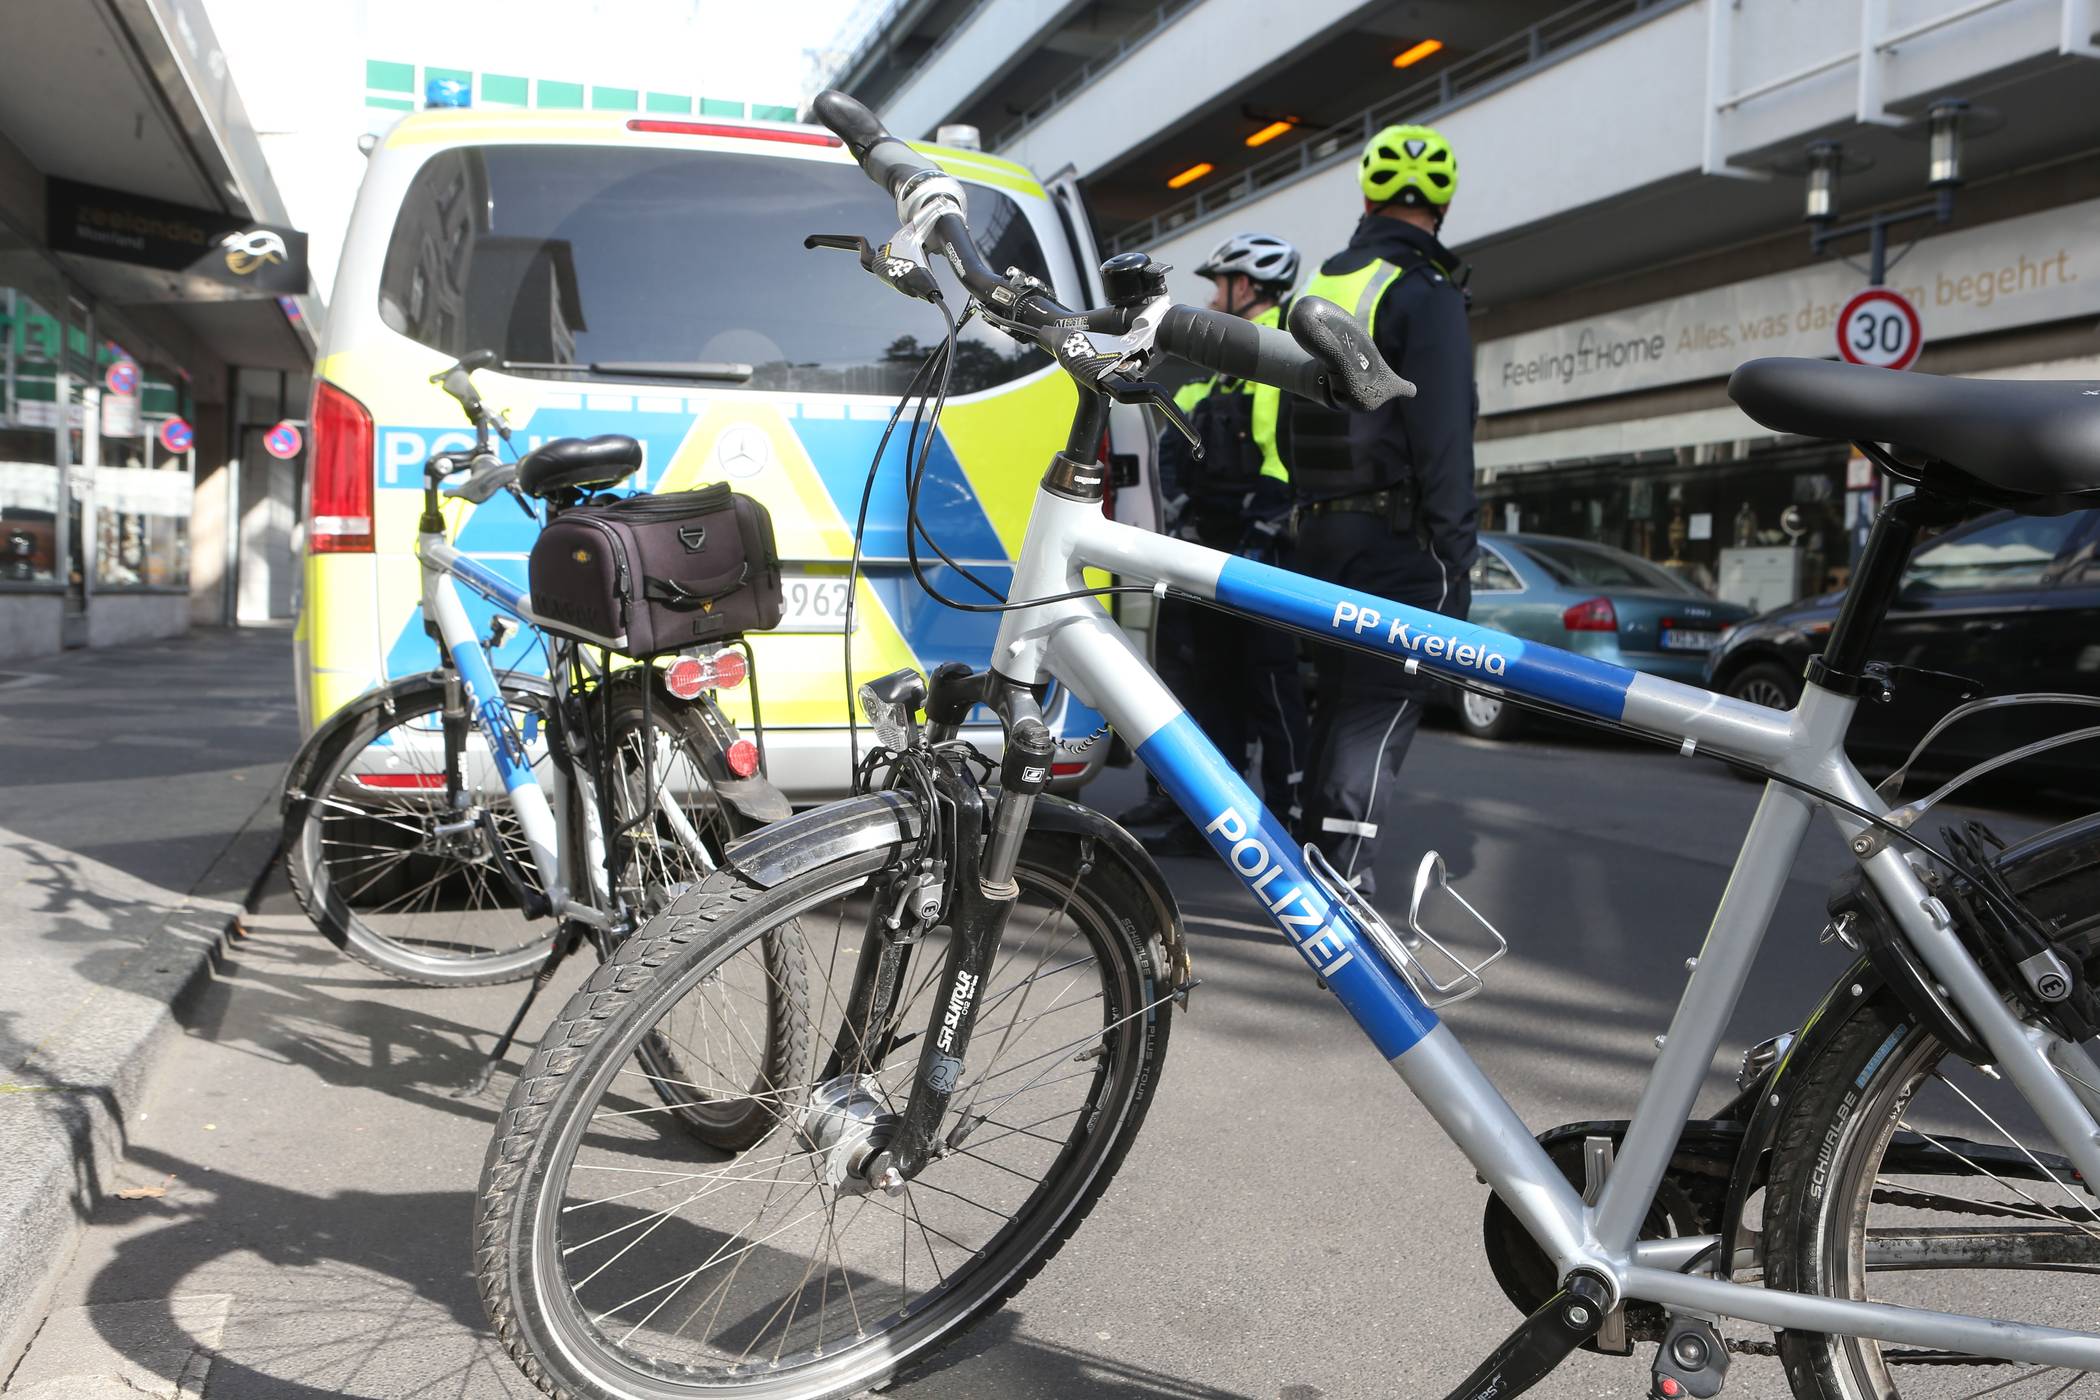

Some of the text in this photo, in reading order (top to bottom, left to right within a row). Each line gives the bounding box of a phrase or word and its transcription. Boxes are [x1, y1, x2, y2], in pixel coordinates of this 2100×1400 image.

[1596, 334, 1665, 371] Home
[1739, 311, 1788, 341] was
[1935, 247, 2078, 308] begehrt.
[1853, 311, 1905, 353] 30
[783, 583, 848, 616] 962
[1332, 600, 1381, 635] PP
[1204, 806, 1354, 978] POLIZEI
[1121, 917, 1150, 976] SCHWALBE
[944, 970, 973, 1031] SUNTOUR
[1146, 1025, 1156, 1061] PLUS
[1135, 1066, 1150, 1101] TOUR
[1810, 1090, 1857, 1199] SCHWALBE
